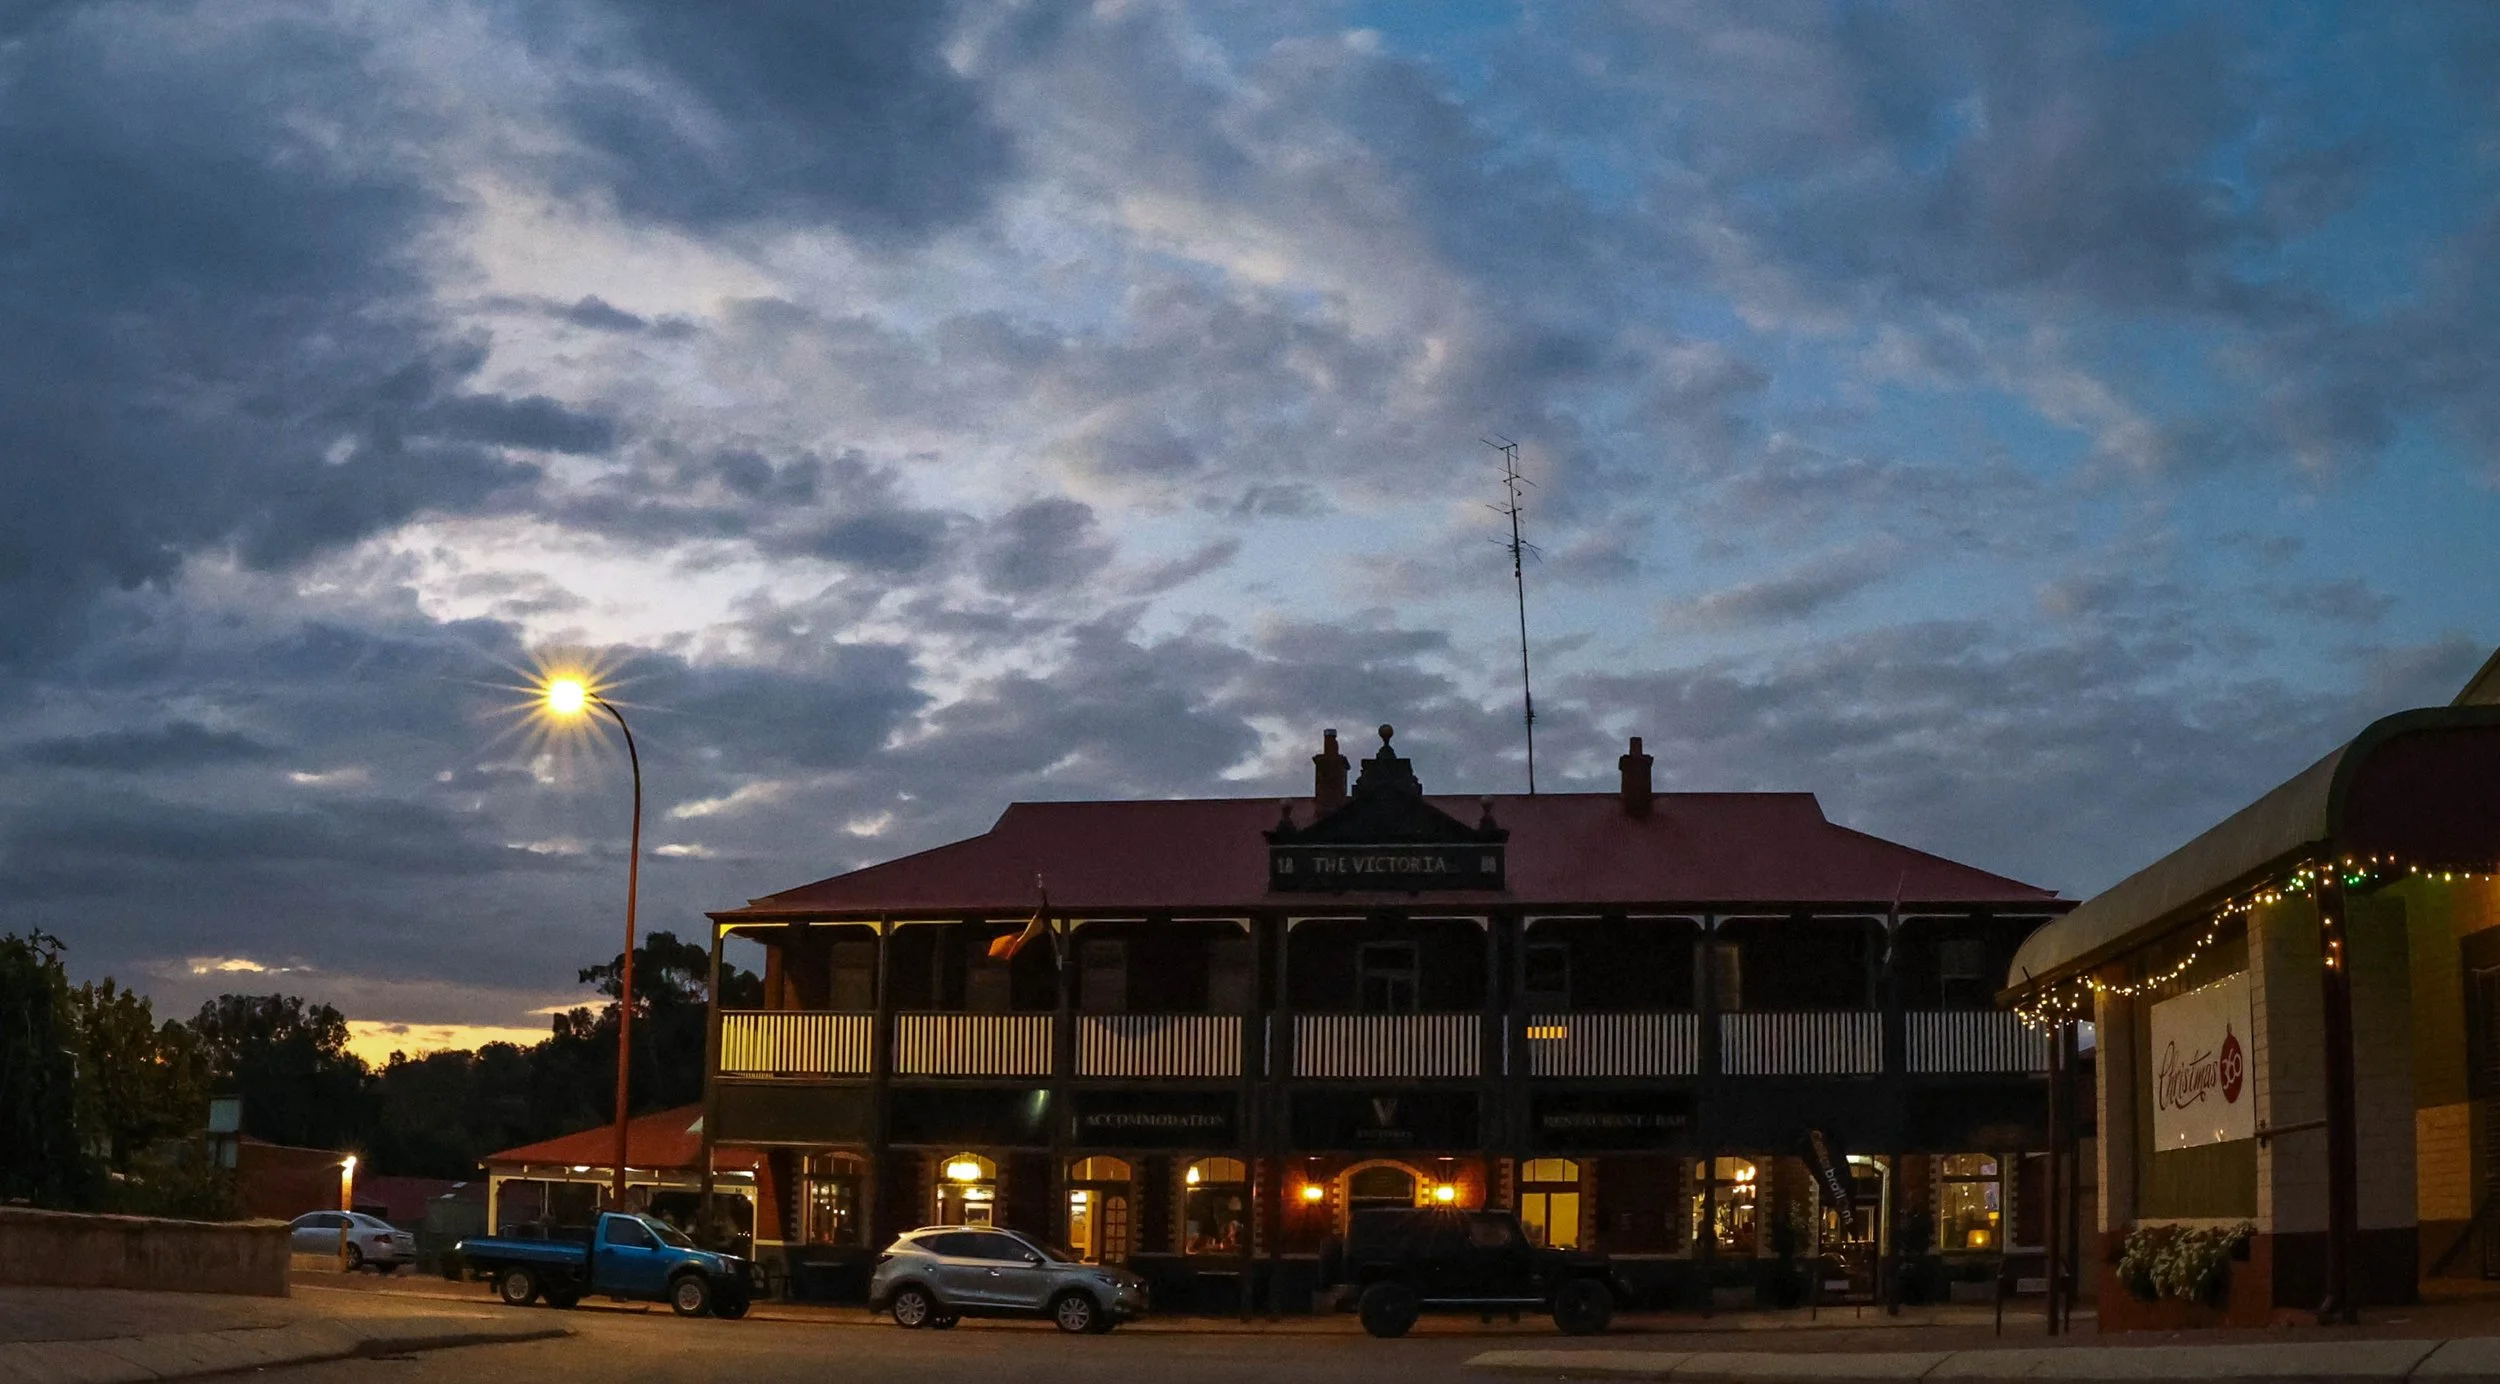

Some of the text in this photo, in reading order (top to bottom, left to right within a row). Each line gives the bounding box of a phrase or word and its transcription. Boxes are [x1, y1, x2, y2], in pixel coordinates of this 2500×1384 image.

[1313, 856, 1346, 873] THE
[1352, 856, 1446, 873] VICTORIA
[2159, 1041, 2243, 1111] Christmas 360
[1085, 1112, 1225, 1128] ACCOMMODATION
